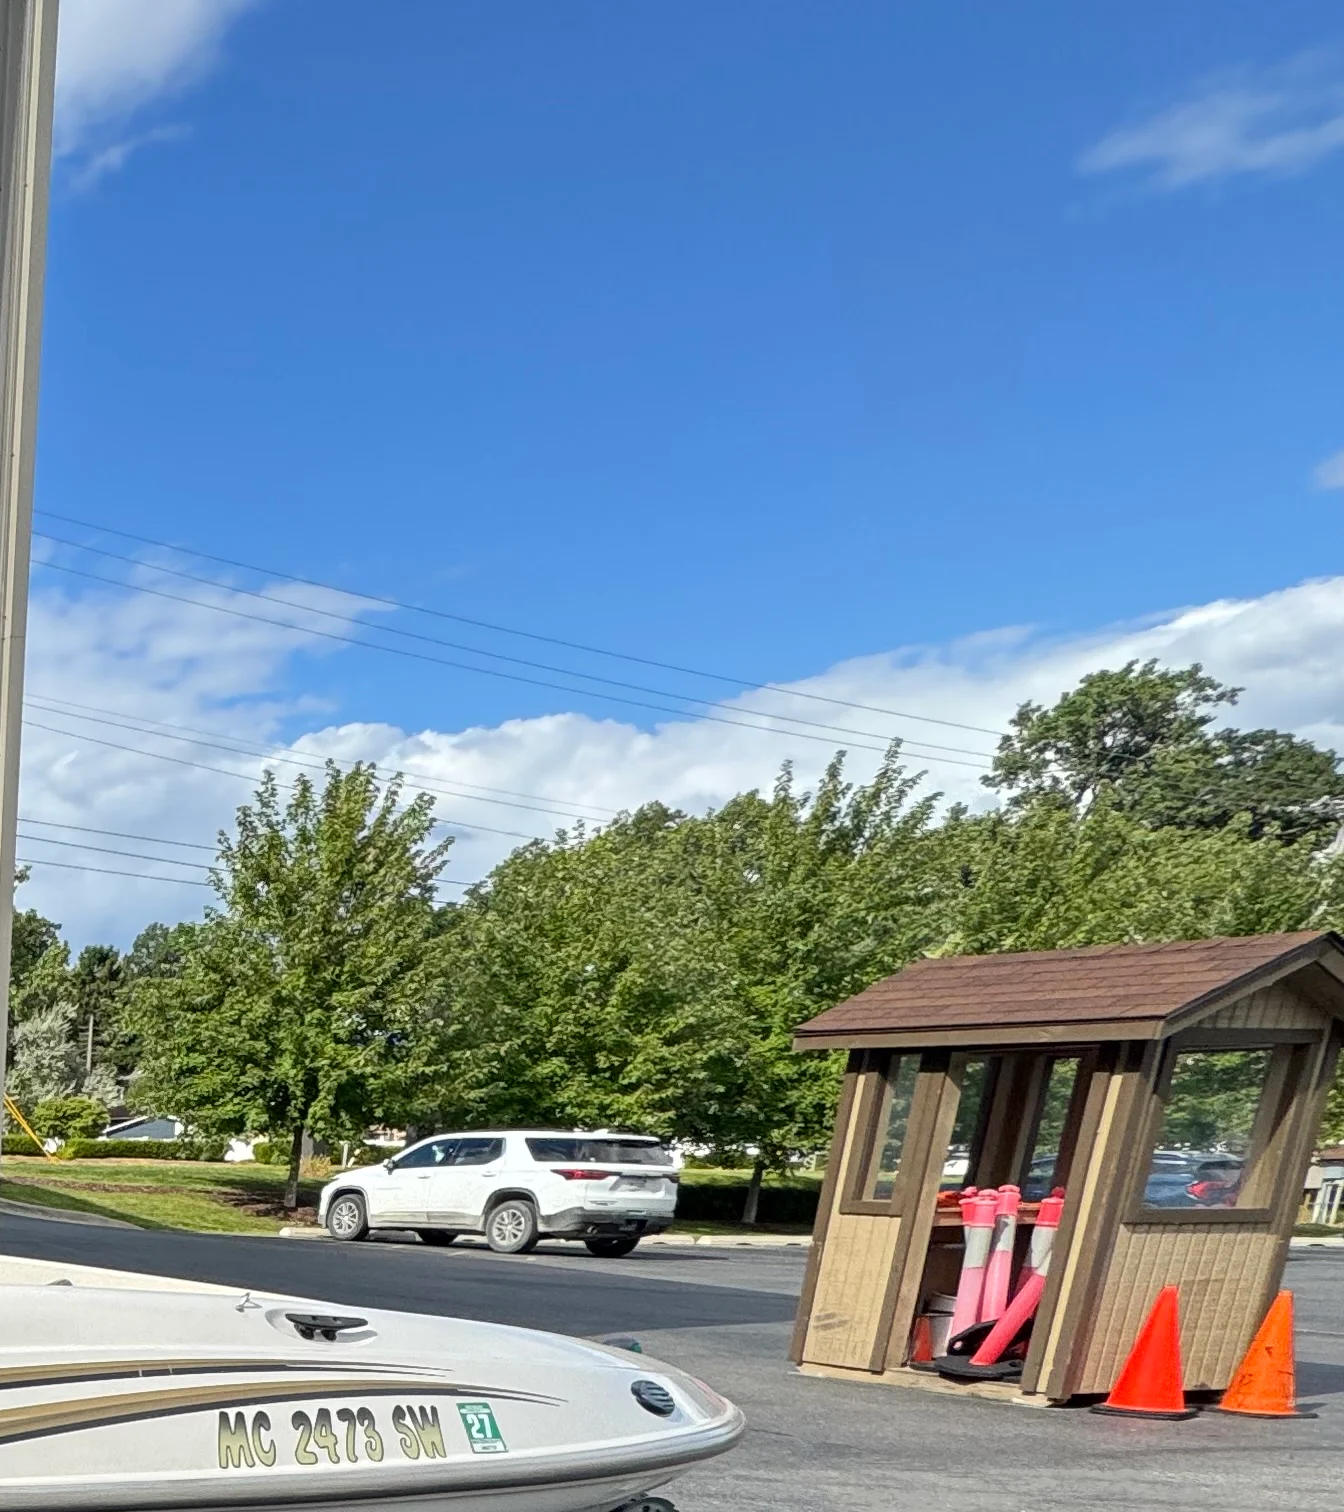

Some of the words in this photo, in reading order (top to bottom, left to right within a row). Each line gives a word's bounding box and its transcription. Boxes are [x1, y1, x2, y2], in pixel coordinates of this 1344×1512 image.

[217, 1410, 277, 1469] MC
[291, 1407, 385, 1466] 2473
[391, 1404, 448, 1460] SW
[465, 1412, 493, 1439] 27
